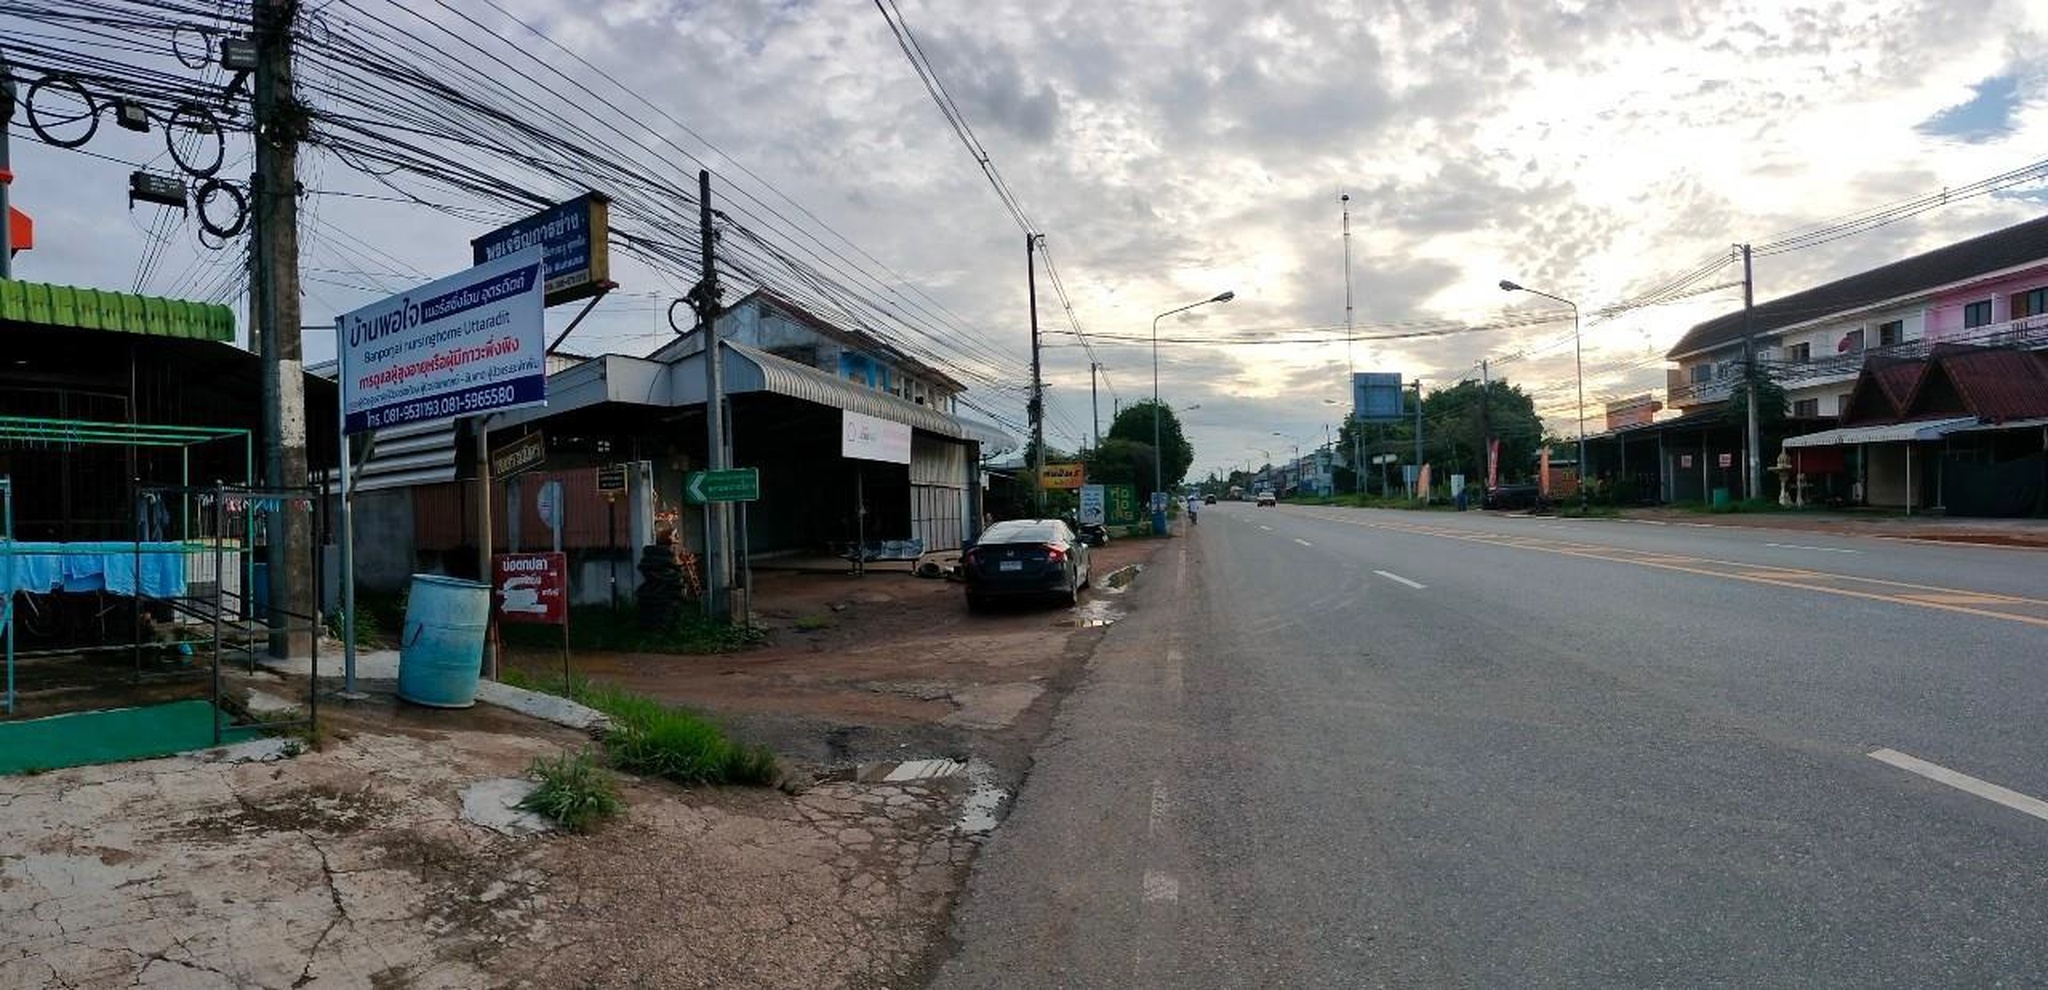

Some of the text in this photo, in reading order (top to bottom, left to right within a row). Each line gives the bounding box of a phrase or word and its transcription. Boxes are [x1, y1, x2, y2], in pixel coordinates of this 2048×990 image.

[351, 298, 420, 347] บ้านพอใจ
[482, 272, 526, 305] อุตรดิตถ์
[464, 312, 511, 336] Uttaradit
[503, 557, 548, 571] บ่อตกปลา
